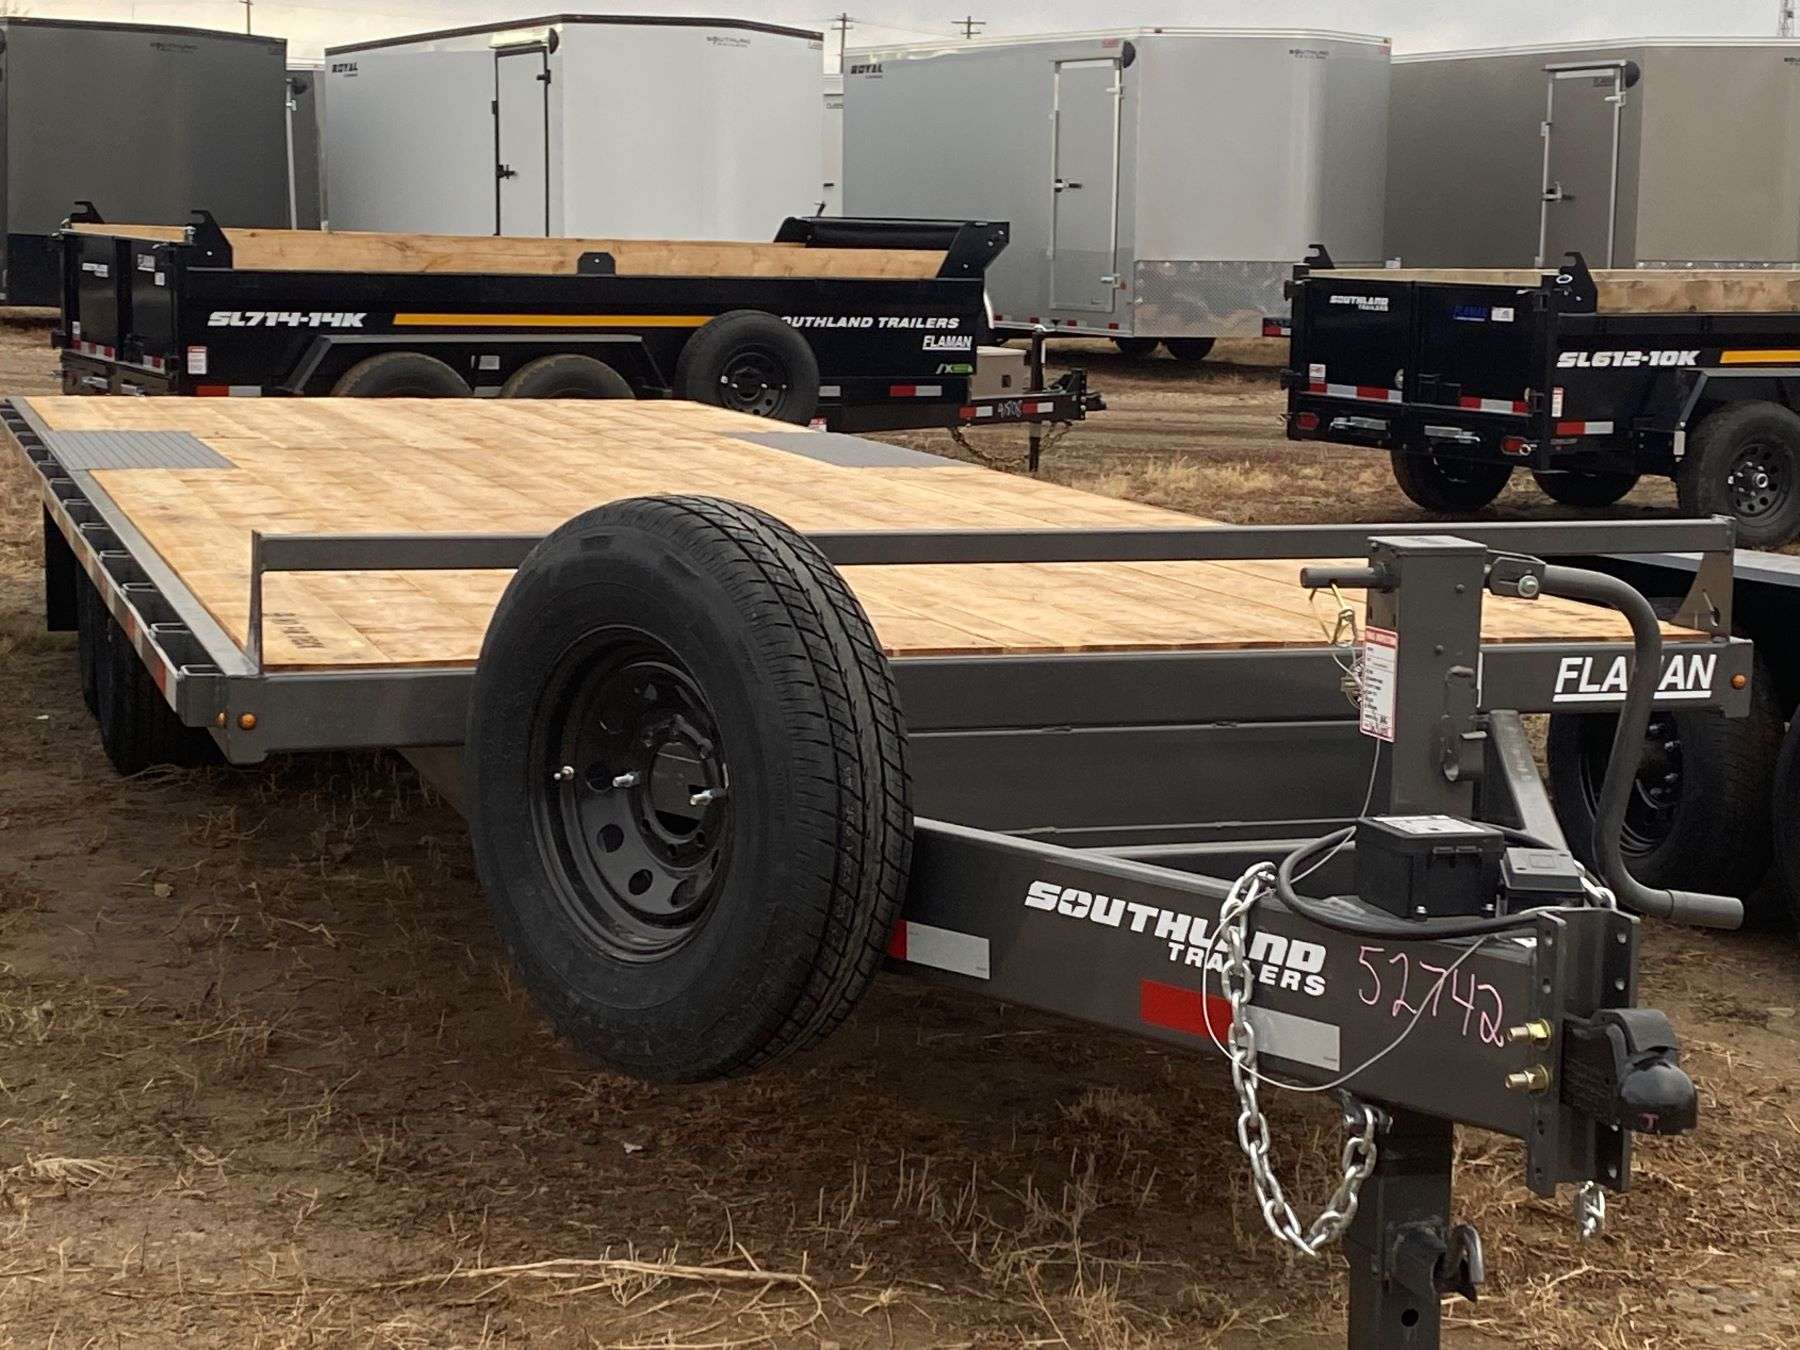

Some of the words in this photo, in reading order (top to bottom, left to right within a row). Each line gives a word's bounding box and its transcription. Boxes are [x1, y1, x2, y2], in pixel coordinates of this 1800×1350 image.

[207, 311, 367, 327] SL714-14K
[781, 315, 874, 328] OUTHLAND
[878, 316, 960, 329] TRAILERS
[922, 335, 973, 349] FLAMAN
[1556, 351, 1700, 368] SL612-10K
[1553, 653, 1717, 695] FLAAN
[1167, 941, 1327, 996] TRAERS
[1359, 945, 1505, 1048] 52742
